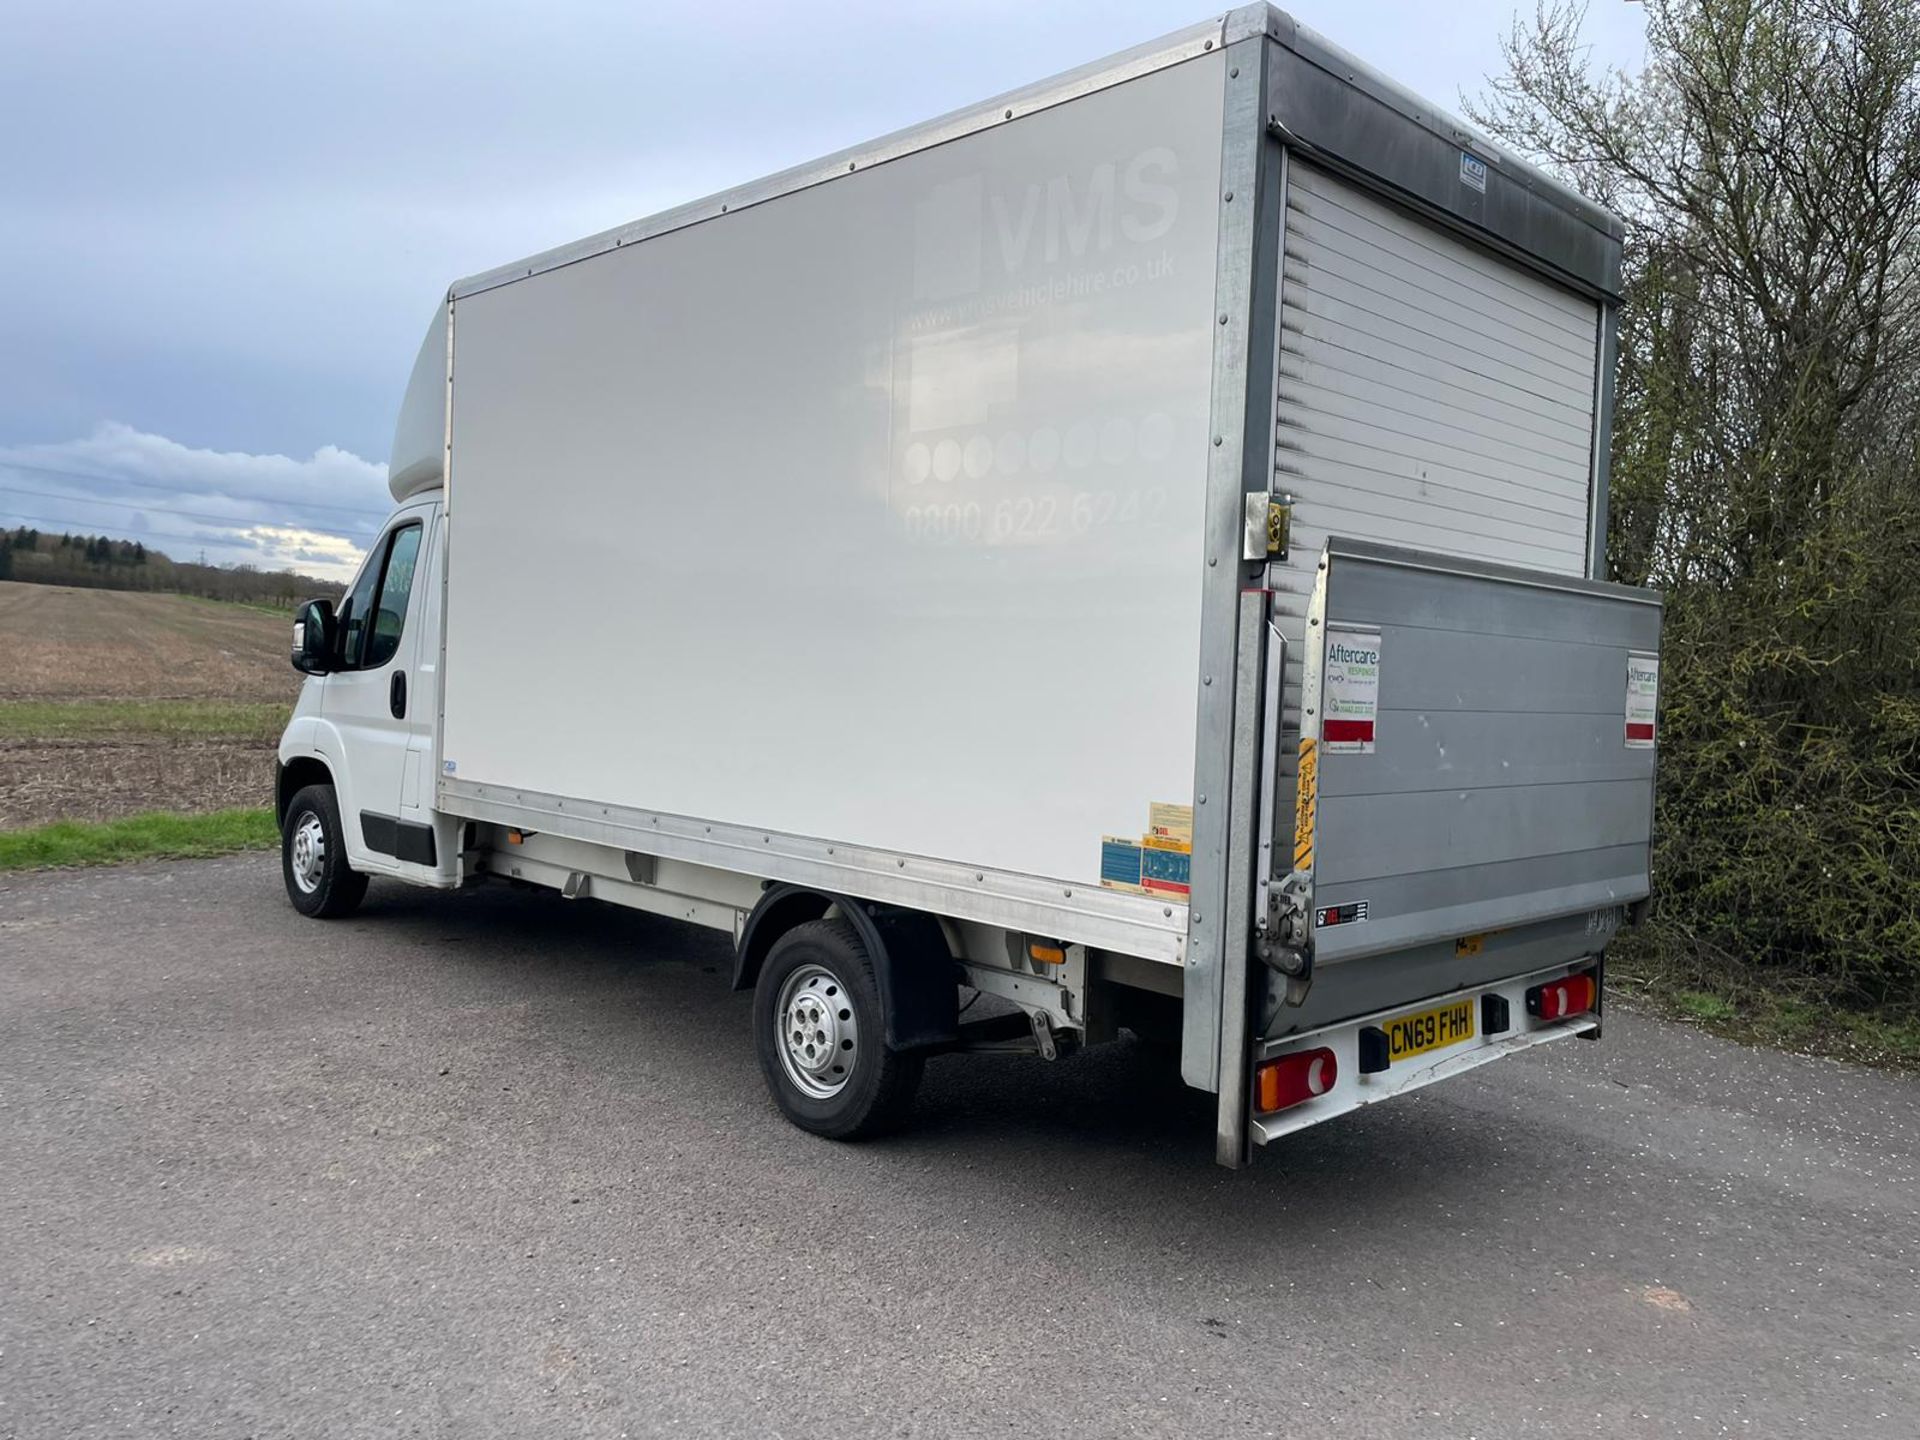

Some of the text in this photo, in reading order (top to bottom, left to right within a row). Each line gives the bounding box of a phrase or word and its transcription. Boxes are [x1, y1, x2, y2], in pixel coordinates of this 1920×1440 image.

[990, 147, 1180, 273] VMS
[903, 500, 982, 543] 0800
[994, 494, 1057, 538] 622
[1329, 643, 1377, 665] Aftercare
[1630, 666, 1657, 683] Aftercare
[1391, 1004, 1468, 1055] CN69 FHH
